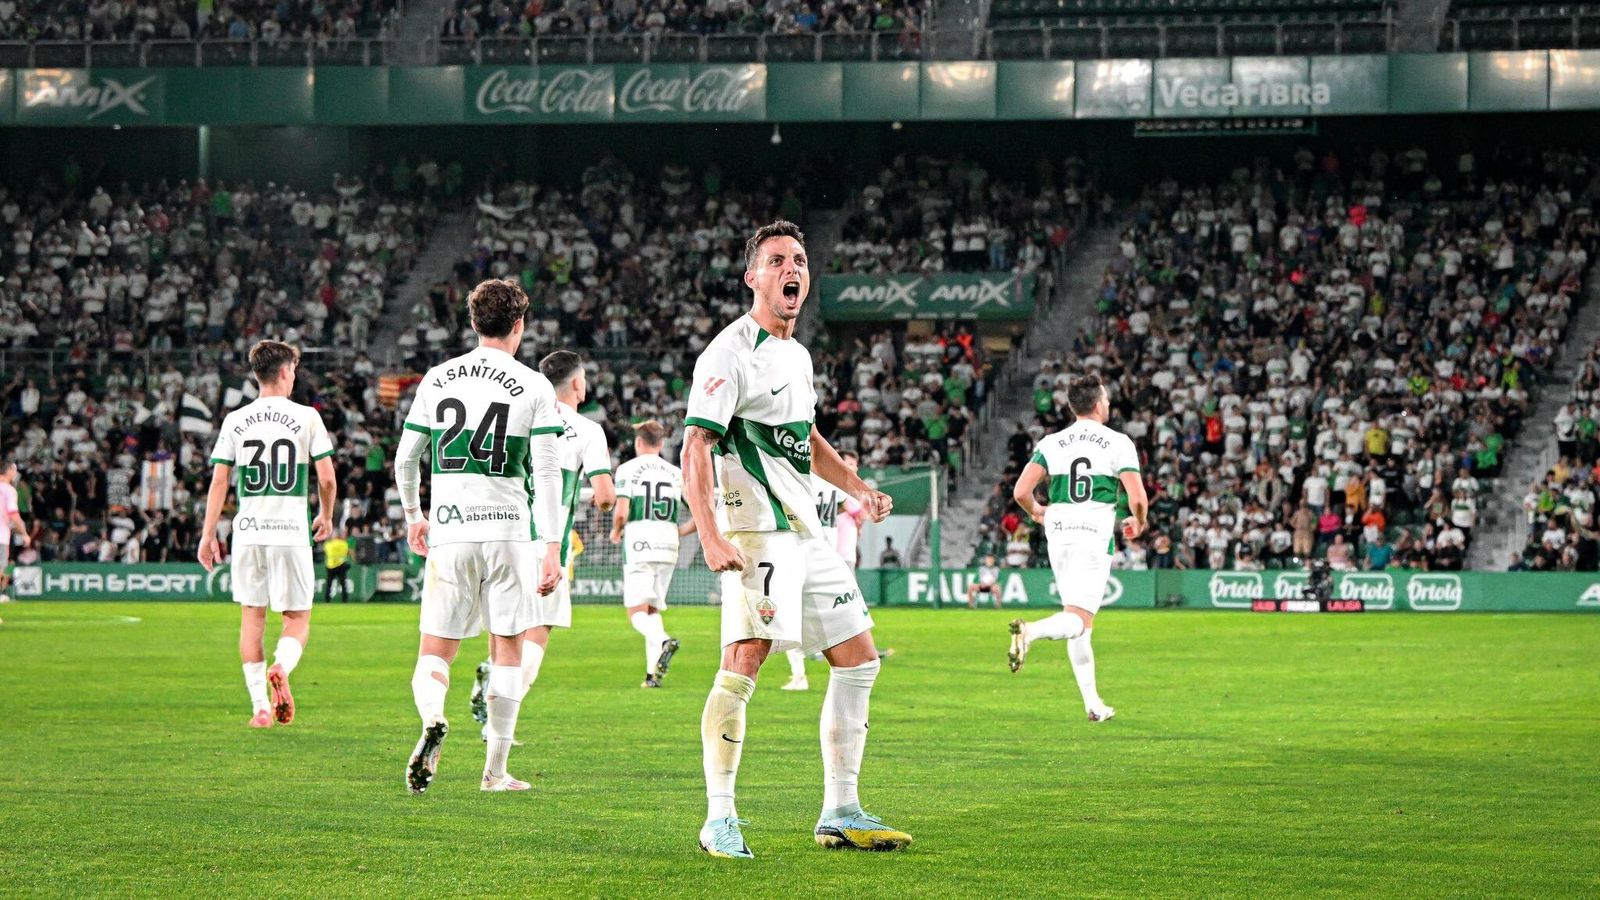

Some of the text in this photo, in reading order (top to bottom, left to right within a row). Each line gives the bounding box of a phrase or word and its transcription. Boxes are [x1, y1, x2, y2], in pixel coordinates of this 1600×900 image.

[435, 397, 511, 475] 24
[242, 437, 298, 494] 30
[1069, 456, 1093, 504] 6
[465, 511, 521, 522] abatibles
[641, 480, 673, 522] 15
[126, 573, 203, 593] PORT
[757, 561, 775, 597] 7
